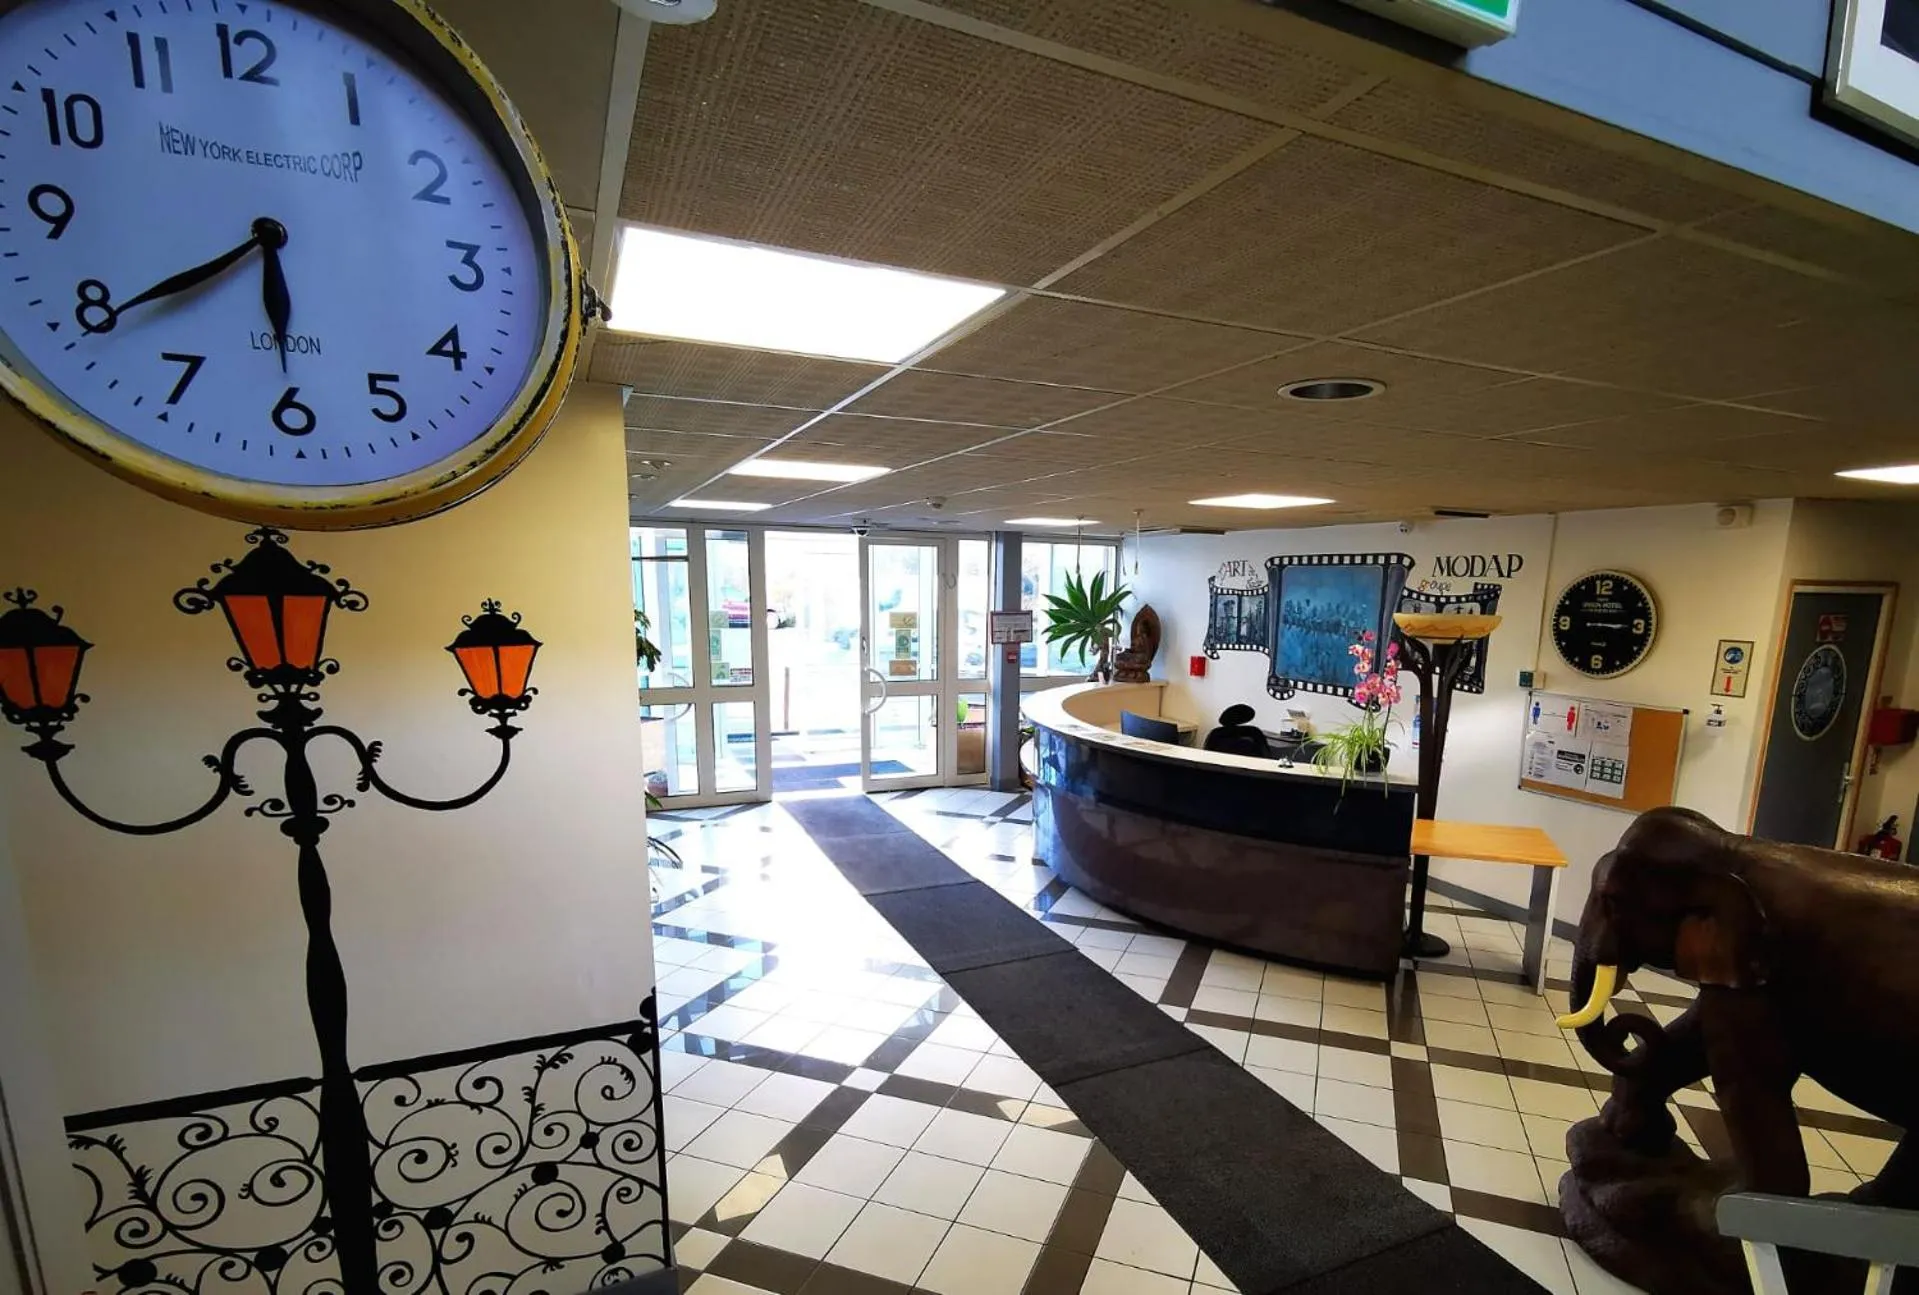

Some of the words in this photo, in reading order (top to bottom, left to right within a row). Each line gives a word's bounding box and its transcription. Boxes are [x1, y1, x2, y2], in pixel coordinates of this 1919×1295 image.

[126, 31, 174, 94] 11
[215, 22, 280, 87] 12
[41, 88, 104, 149] 10
[342, 72, 360, 126] 1
[158, 121, 196, 156] NEW
[199, 138, 243, 163] YORK
[246, 150, 318, 175] ELECTRIC
[320, 151, 363, 183] CORP
[407, 149, 451, 205] 2
[27, 183, 75, 240] 9
[445, 241, 485, 292] 3
[76, 279, 117, 333] 8
[426, 325, 467, 371] 4
[161, 352, 206, 405] 7
[368, 373, 408, 422] 5
[271, 387, 316, 436] 6
[1431, 554, 1523, 578] MODAP
[1595, 580, 1613, 596] 12
[1559, 615, 1571, 630] 9
[1632, 618, 1645, 634] 3
[1591, 654, 1603, 669] 6
